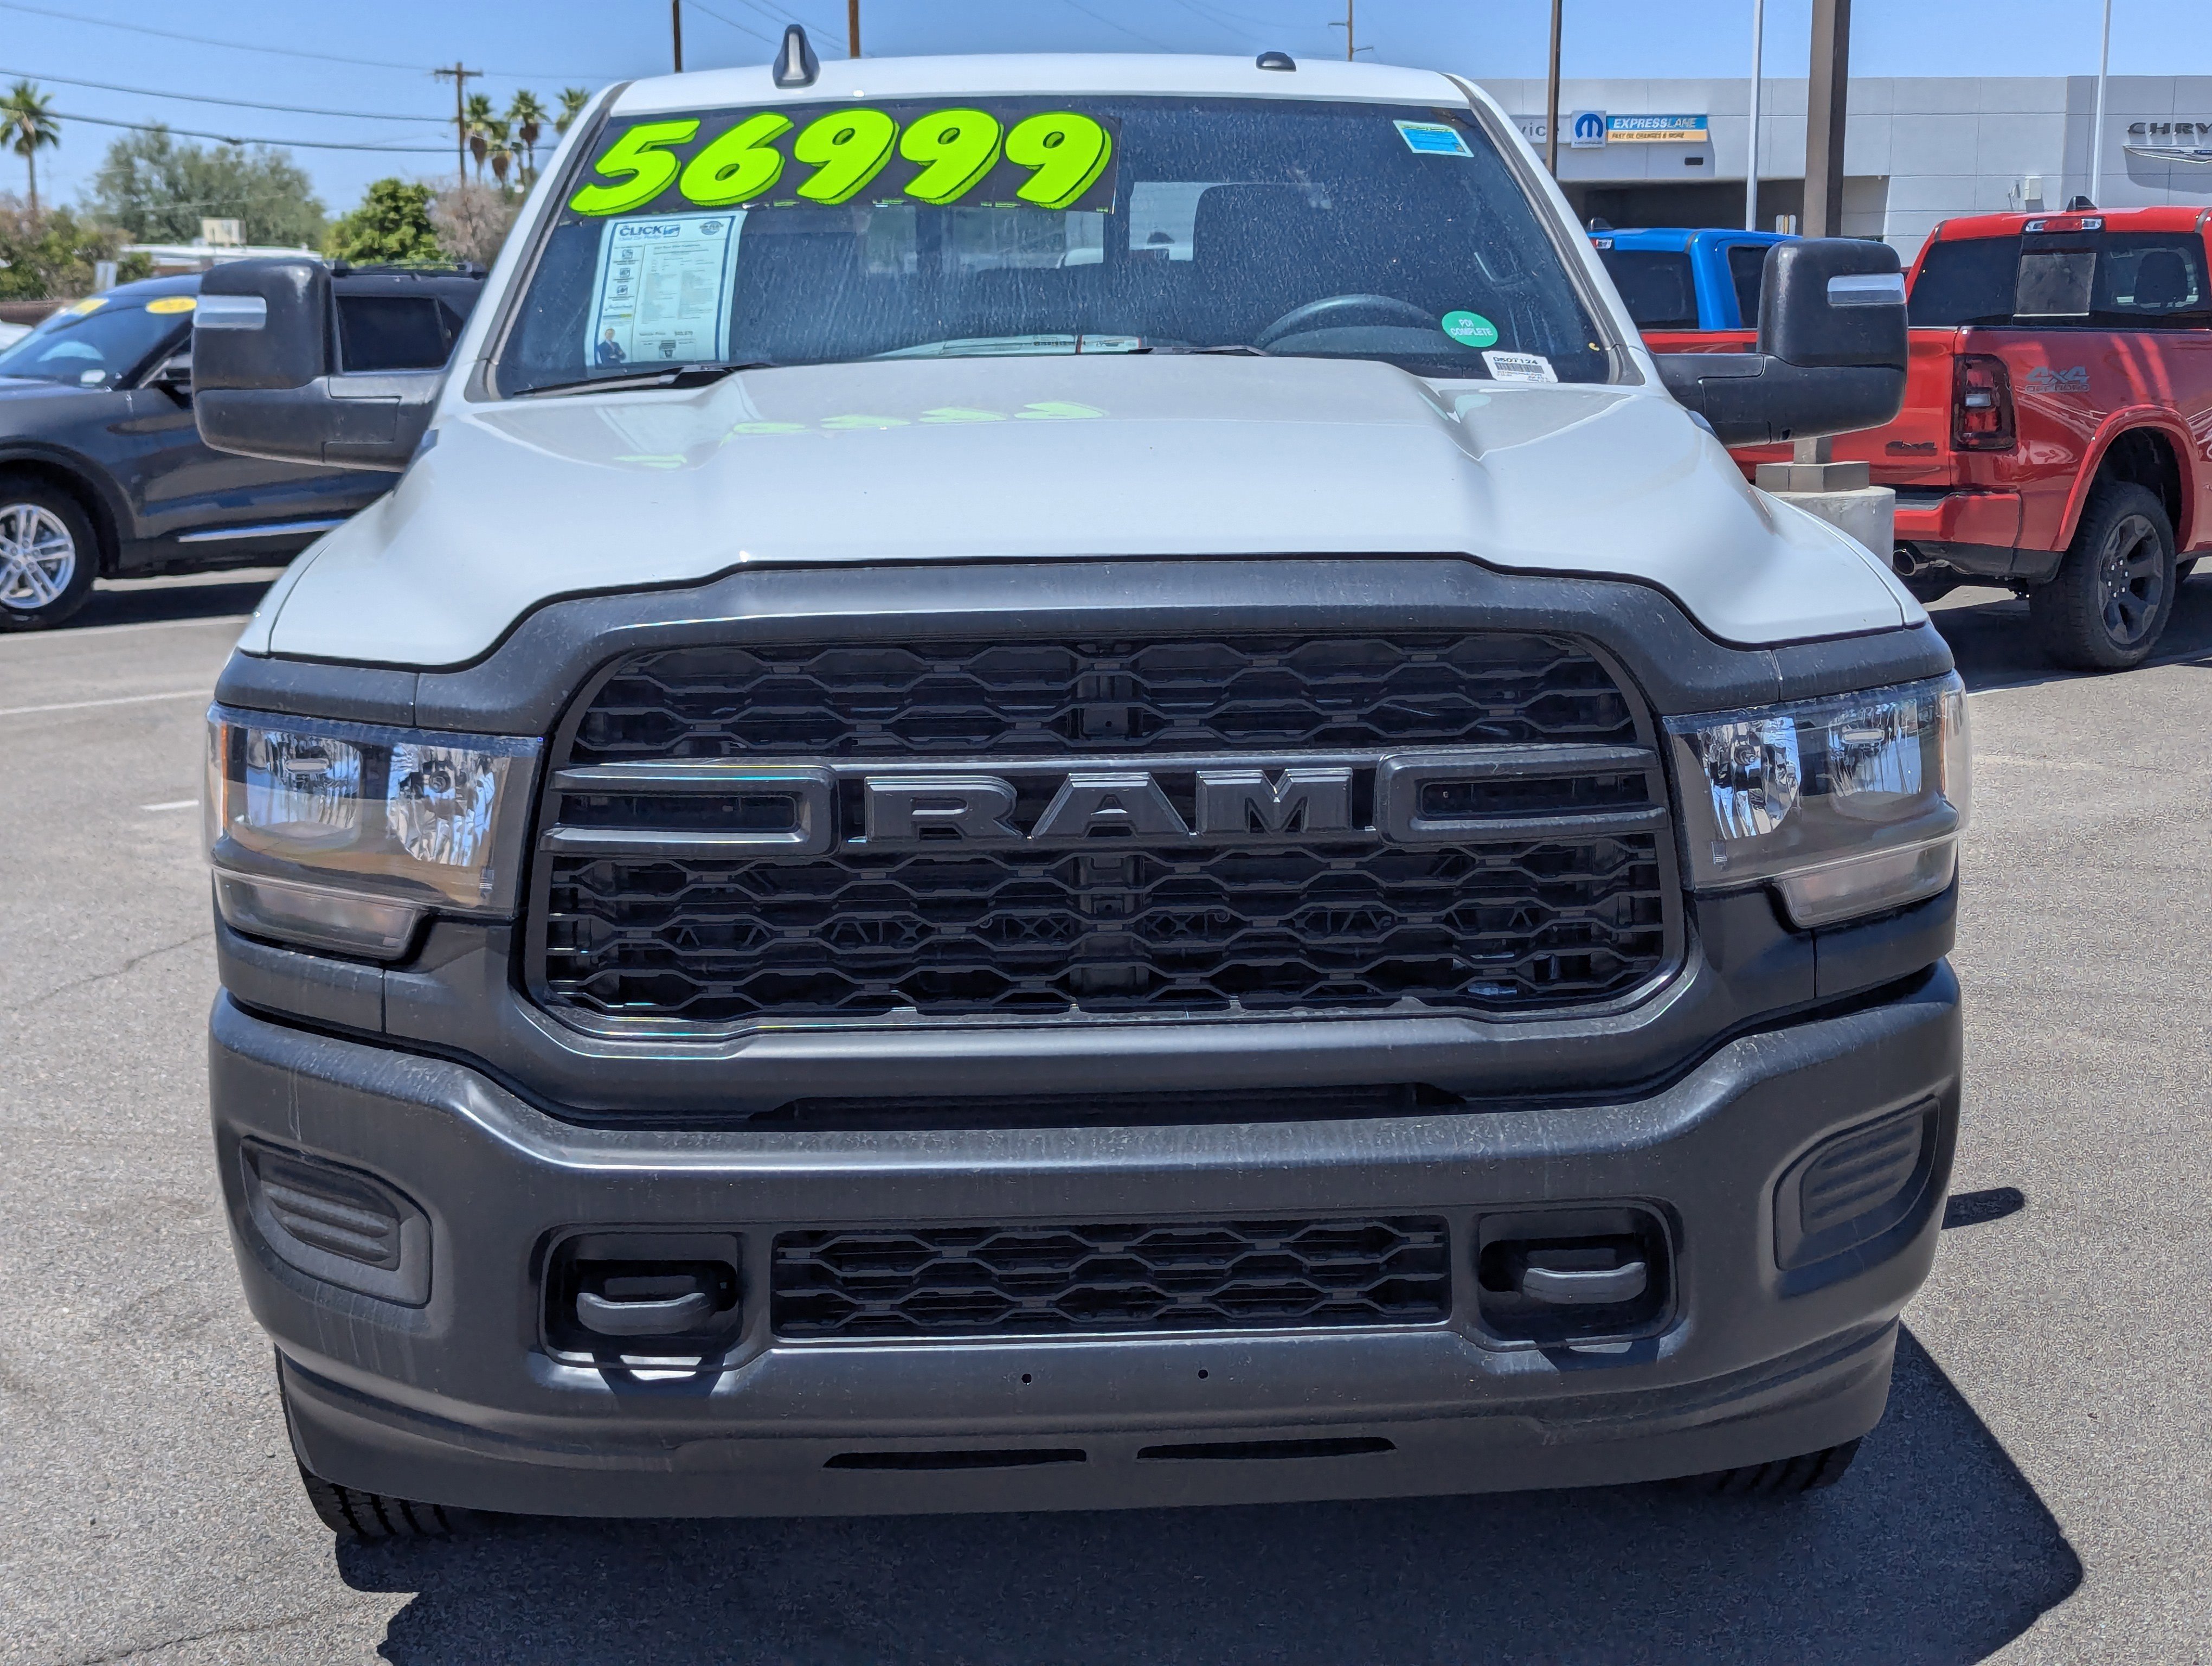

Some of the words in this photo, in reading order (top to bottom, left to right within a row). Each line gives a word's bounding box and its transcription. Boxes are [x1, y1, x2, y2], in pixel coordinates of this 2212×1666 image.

[2128, 122, 2212, 134] CHRY
[568, 108, 1113, 216] 56999
[619, 225, 664, 236] CLICK
[1450, 328, 1494, 336] COMPLETE
[865, 768, 1353, 840] RAM
